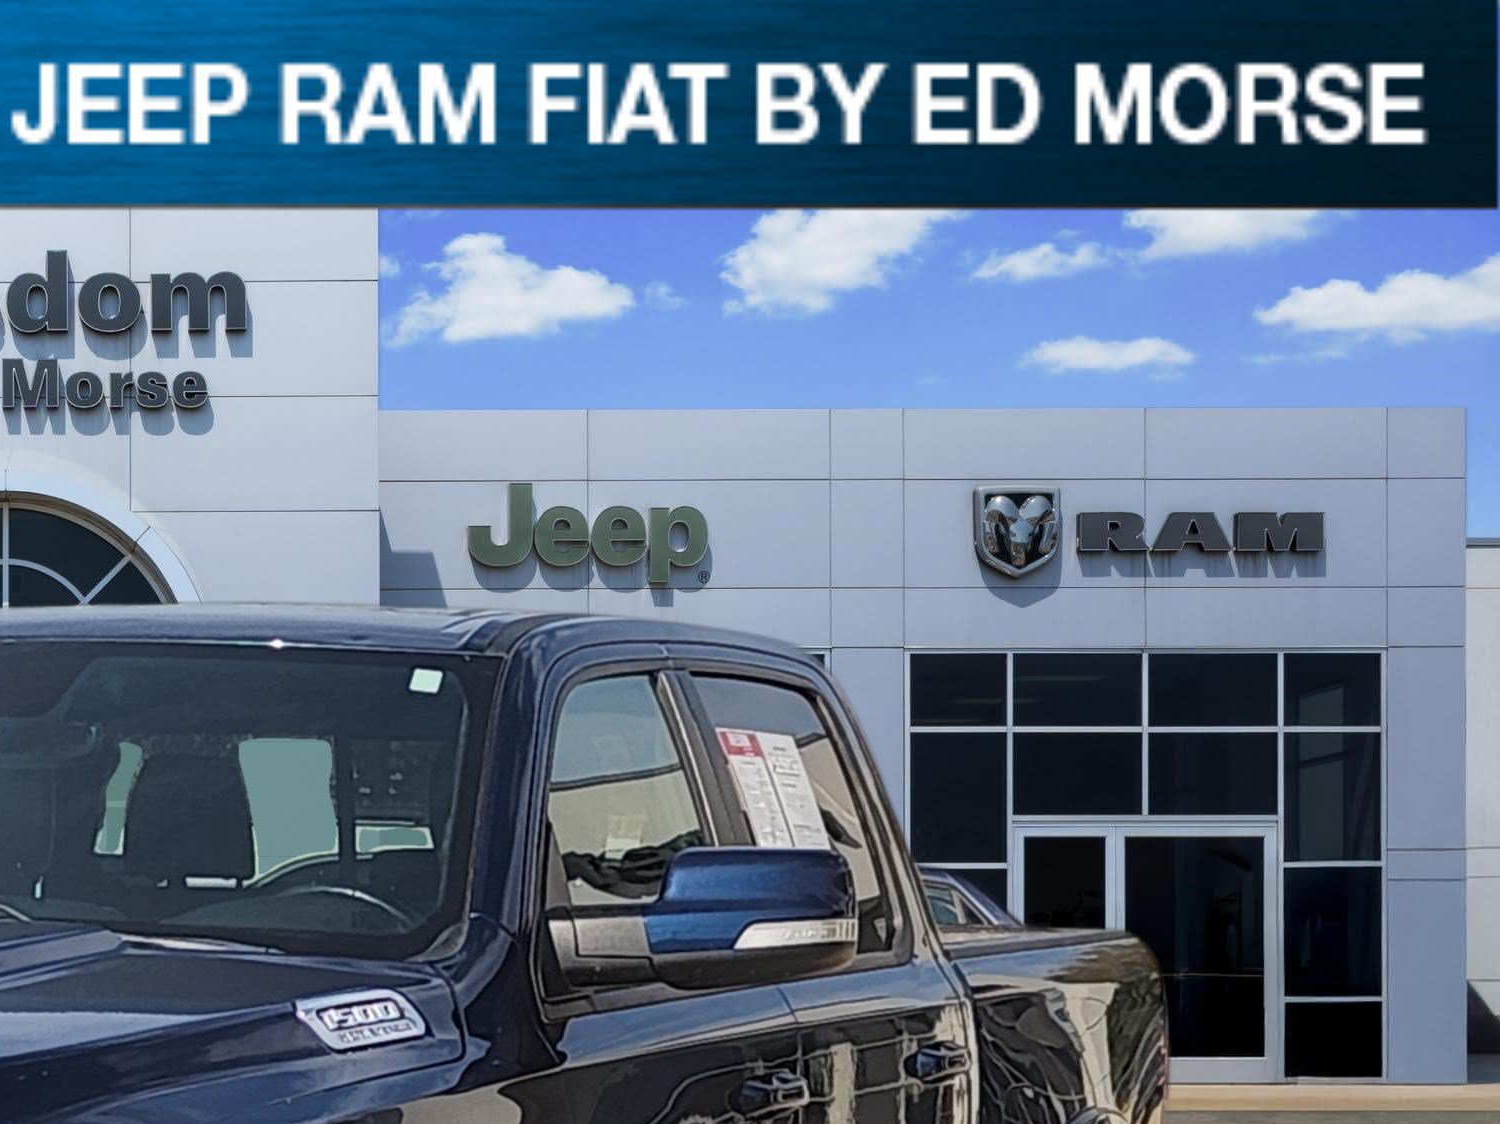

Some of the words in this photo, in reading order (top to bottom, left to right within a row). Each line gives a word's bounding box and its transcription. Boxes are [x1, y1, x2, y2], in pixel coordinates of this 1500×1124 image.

[2, 357, 209, 409] Morse
[466, 483, 709, 583] Jeep
[1076, 511, 1326, 552] RAM
[322, 1000, 401, 1031] 1500
